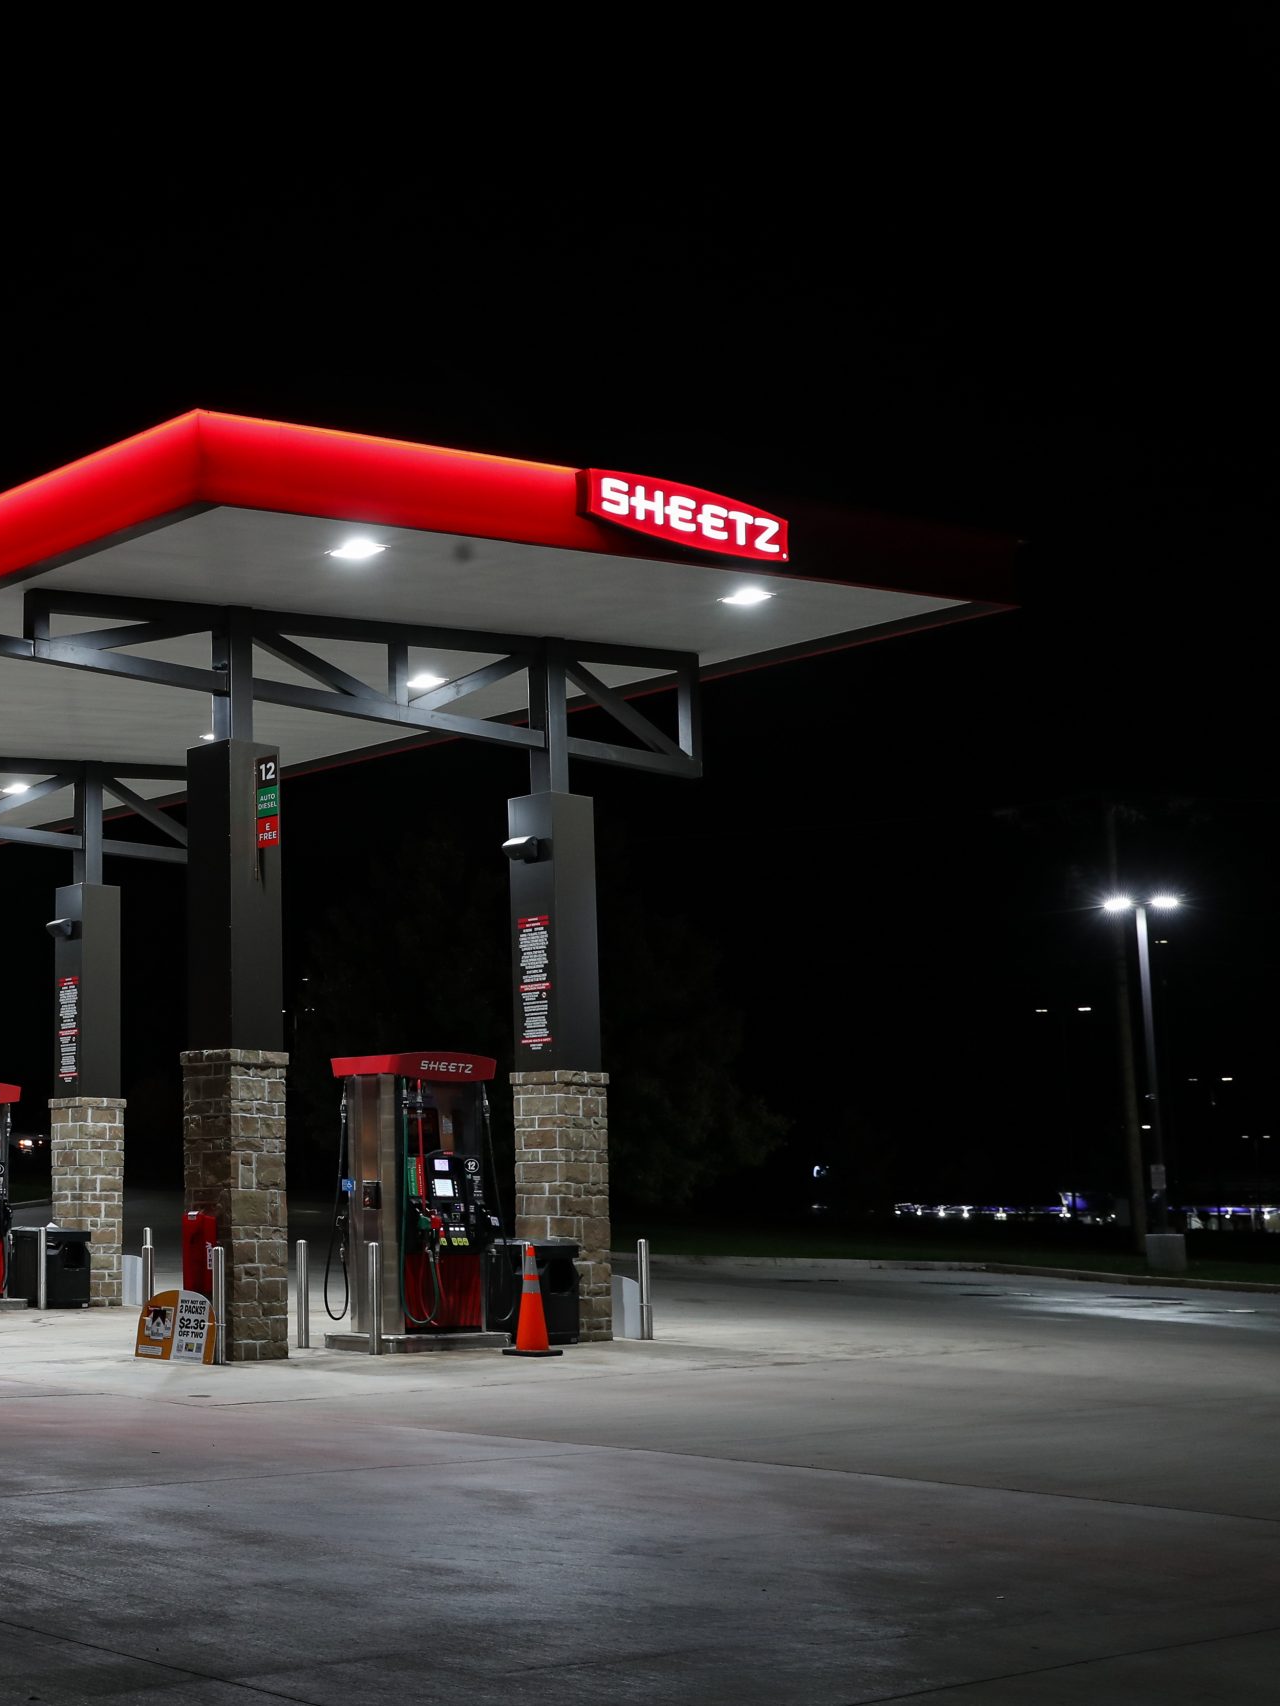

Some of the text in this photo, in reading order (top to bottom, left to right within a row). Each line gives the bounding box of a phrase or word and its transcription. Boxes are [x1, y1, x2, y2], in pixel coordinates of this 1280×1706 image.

[601, 477, 780, 553] SHEETZ
[260, 762, 276, 781] 12
[260, 793, 276, 802] AUTO
[258, 801, 278, 810] DIESEL
[266, 823, 271, 831] E
[259, 831, 277, 842] FREE
[421, 1061, 473, 1074] SHEETZ
[467, 1161, 476, 1170] 12
[179, 1304, 206, 1315] 2 PACKS?
[190, 1331, 204, 1339] TWO
